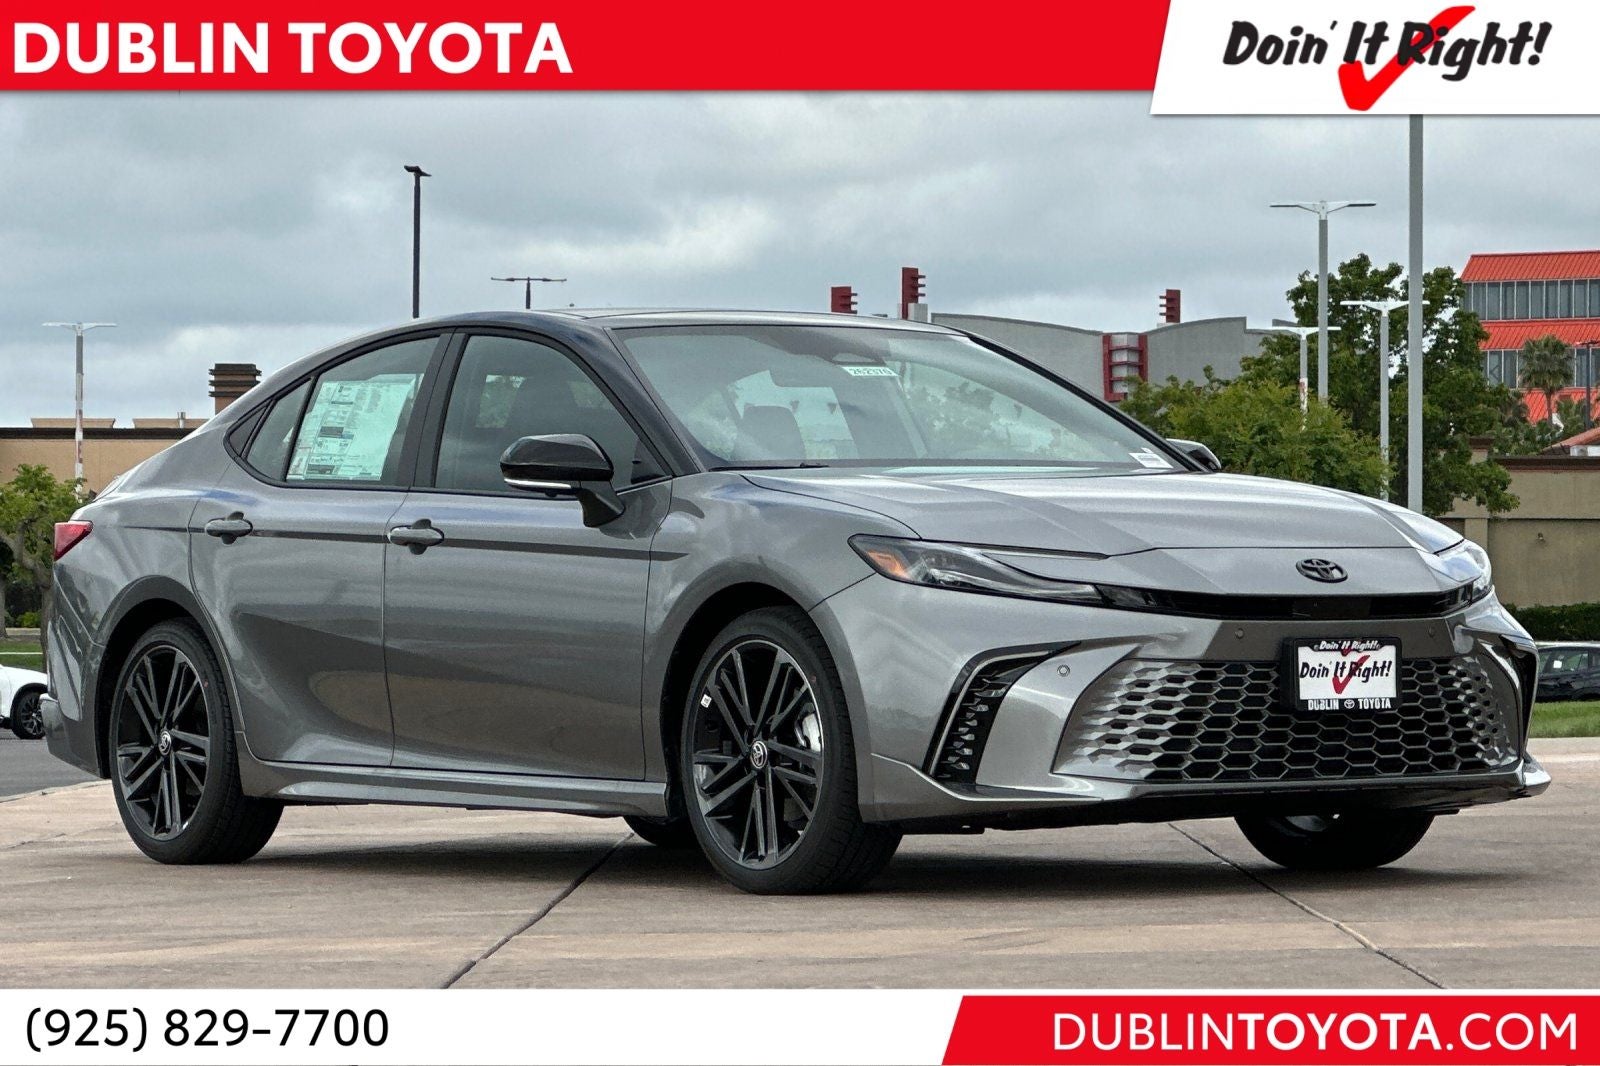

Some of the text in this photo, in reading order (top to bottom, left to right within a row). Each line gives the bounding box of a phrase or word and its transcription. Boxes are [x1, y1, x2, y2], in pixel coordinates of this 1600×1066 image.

[1300, 660, 1393, 683] Doin' It Right!
[1307, 698, 1392, 711] DUBLIN TOYOTA
